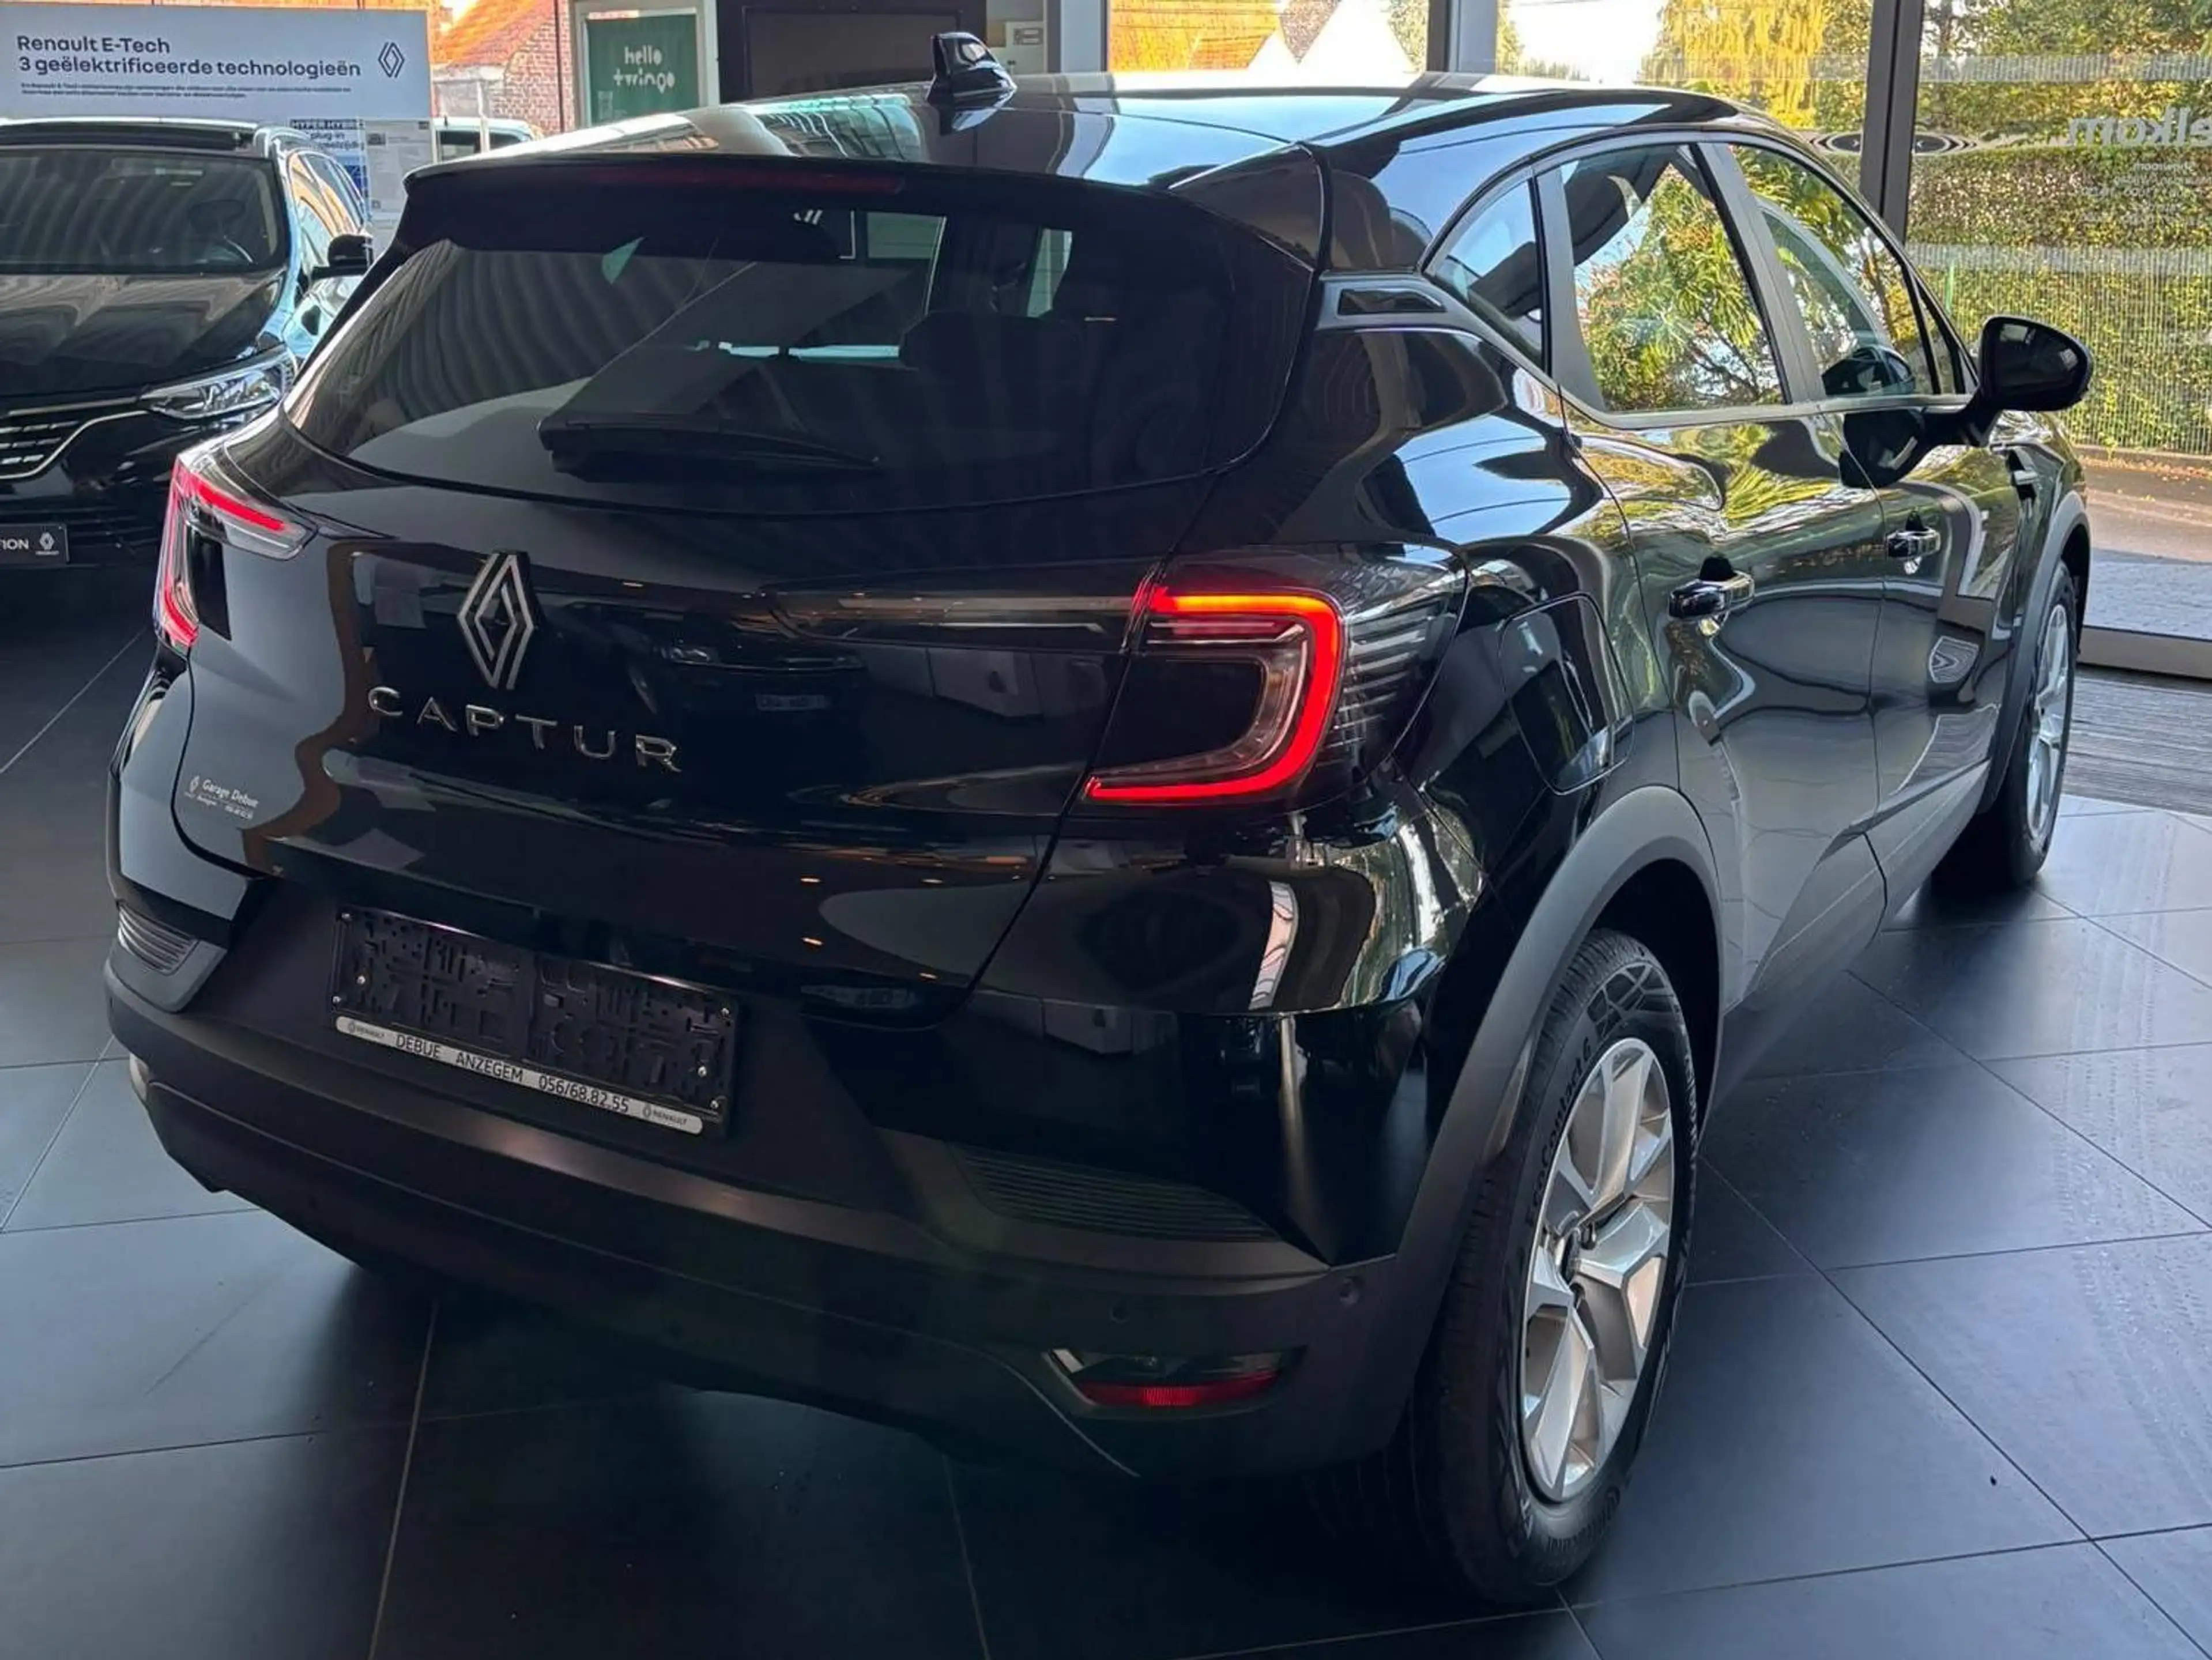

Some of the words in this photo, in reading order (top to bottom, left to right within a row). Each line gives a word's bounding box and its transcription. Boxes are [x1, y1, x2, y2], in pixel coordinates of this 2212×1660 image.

[17, 35, 98, 52] Renault
[102, 37, 171, 53] E-Tech
[624, 44, 662, 66] hello
[18, 57, 31, 71] 3
[35, 55, 213, 76] geëlektrificeerde
[216, 59, 361, 79] technologieën
[613, 67, 675, 94] twingo
[0, 538, 29, 550] ION
[368, 686, 682, 772] CAPTUR
[396, 1034, 442, 1058] DEBUE
[456, 1051, 523, 1082] ANZEGEM
[538, 1075, 630, 1114] 056/68.82.55
